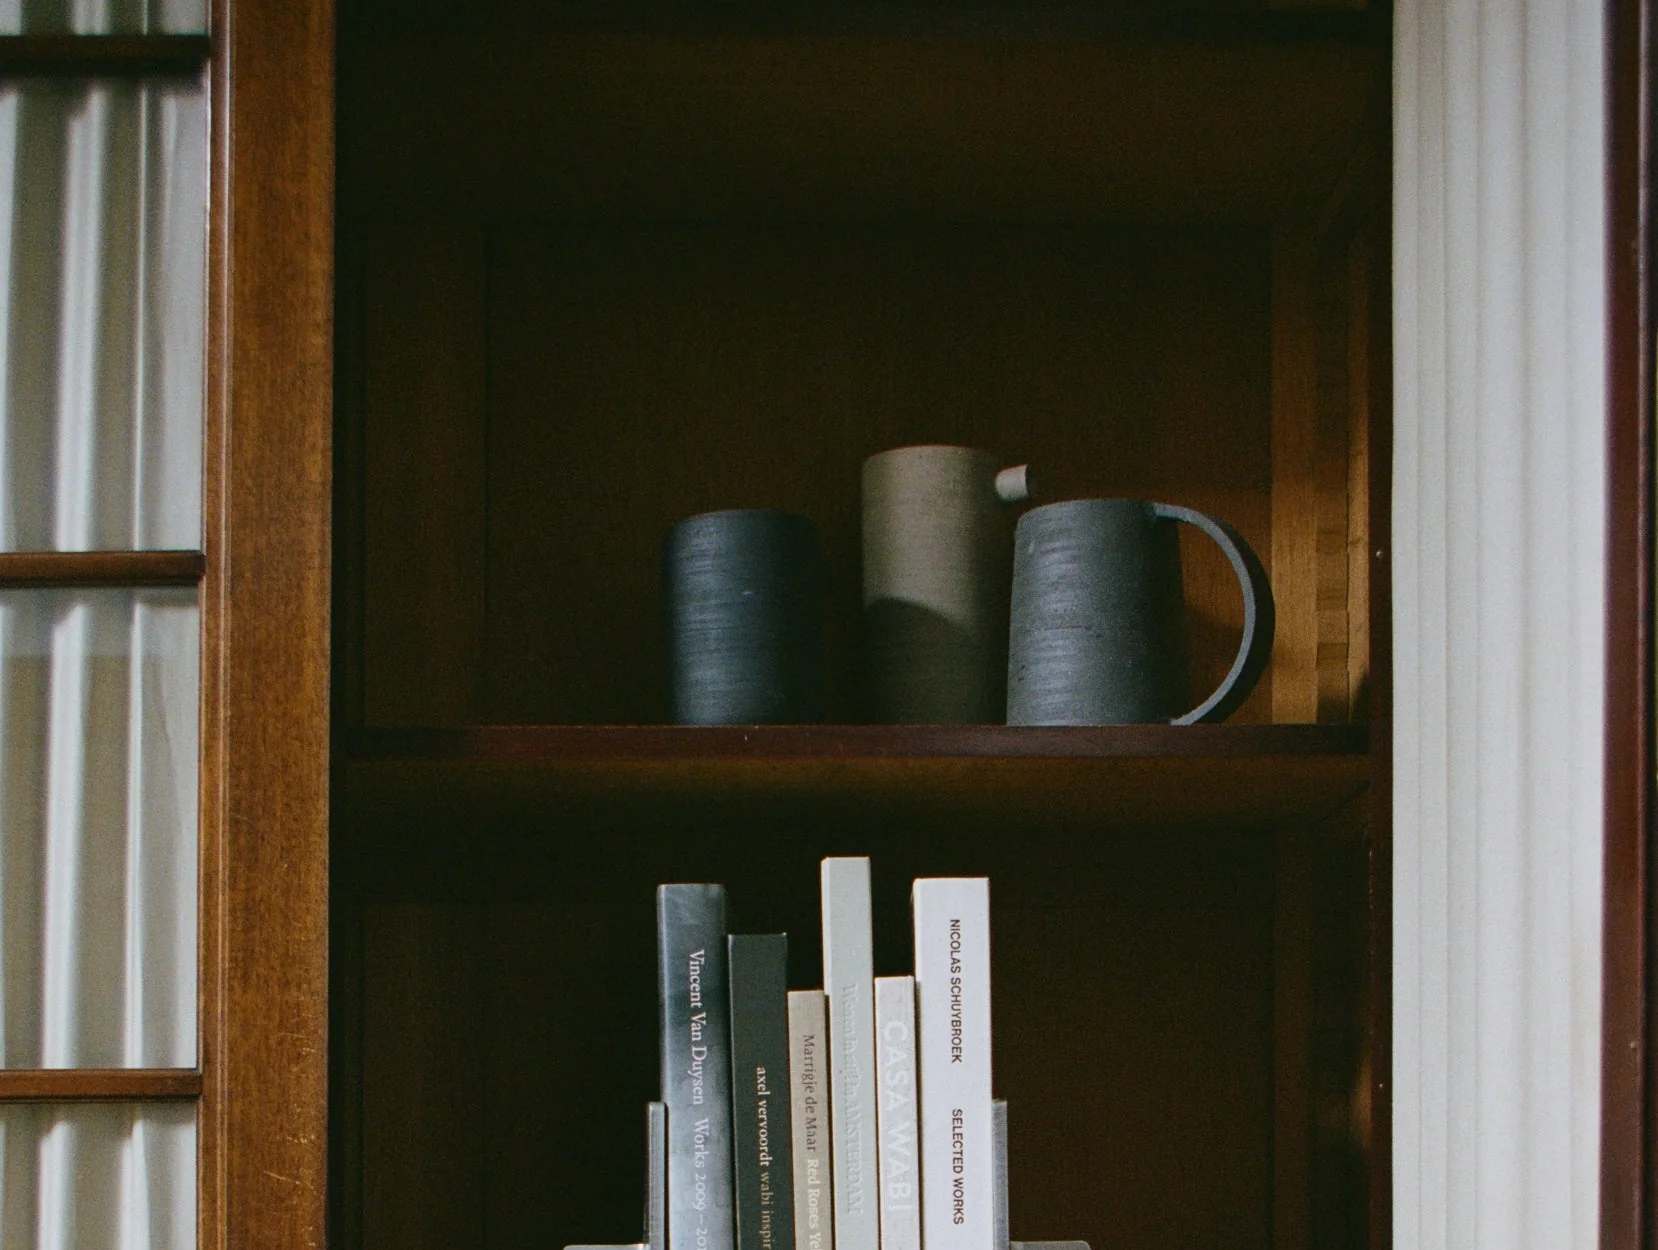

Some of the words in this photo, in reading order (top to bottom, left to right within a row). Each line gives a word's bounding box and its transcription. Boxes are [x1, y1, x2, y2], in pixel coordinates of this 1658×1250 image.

[950, 919, 962, 974] NICOLAS
[689, 949, 705, 1008] Vincent
[691, 1011, 707, 1041] Van
[950, 976, 963, 1064] SCHUYBROEK
[688, 1045, 708, 1105] Duysen
[757, 1066, 771, 1095] axel
[802, 1034, 816, 1093] Marrigje
[883, 1021, 909, 1110] CASA
[805, 1096, 818, 1113] de
[694, 1118, 709, 1168] Works
[758, 1100, 773, 1166] vervoordt
[806, 1117, 818, 1152] Maar
[845, 1103, 864, 1215] AMSTERDAM
[951, 1109, 964, 1174] SELECTED
[761, 1171, 774, 1206] wabi
[807, 1158, 821, 1184] Red
[887, 1119, 912, 1211] WABI
[808, 1188, 821, 1228] Roses
[952, 1176, 965, 1225] WORKS
